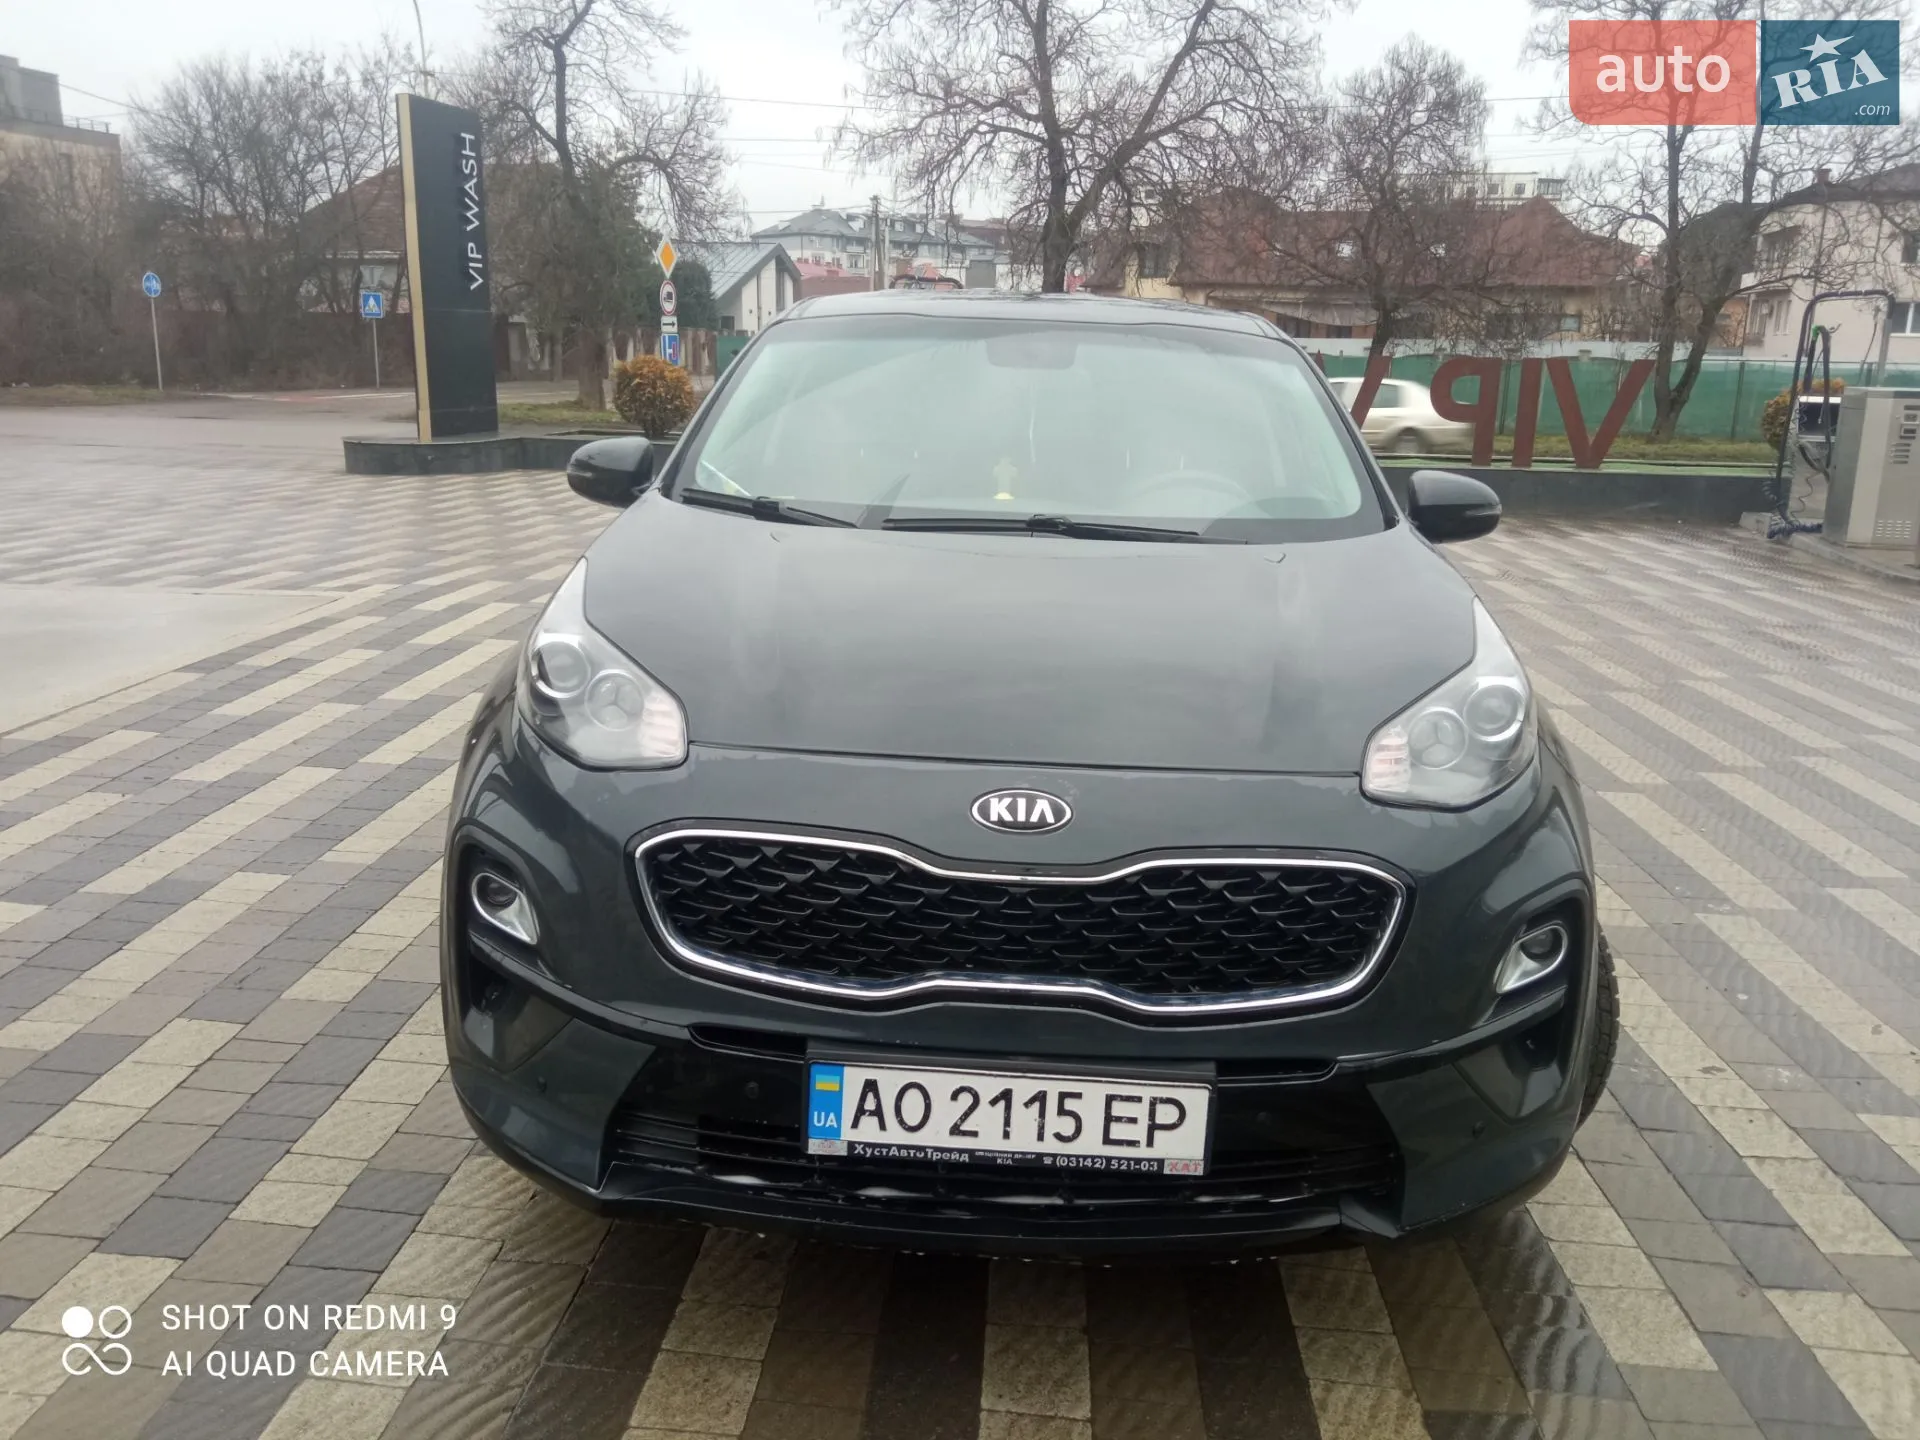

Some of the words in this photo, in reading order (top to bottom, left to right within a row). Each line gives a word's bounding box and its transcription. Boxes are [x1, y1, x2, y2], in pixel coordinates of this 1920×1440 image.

[460, 132, 480, 231] WASH
[467, 242, 484, 291] VIP
[988, 797, 1056, 824] KIA
[813, 1111, 838, 1129] UA
[850, 1078, 932, 1133] AO
[948, 1085, 1083, 1145] 2115
[1101, 1093, 1188, 1149] EP
[1056, 1155, 1106, 1169] (03142)
[1110, 1158, 1158, 1171] 521-03
